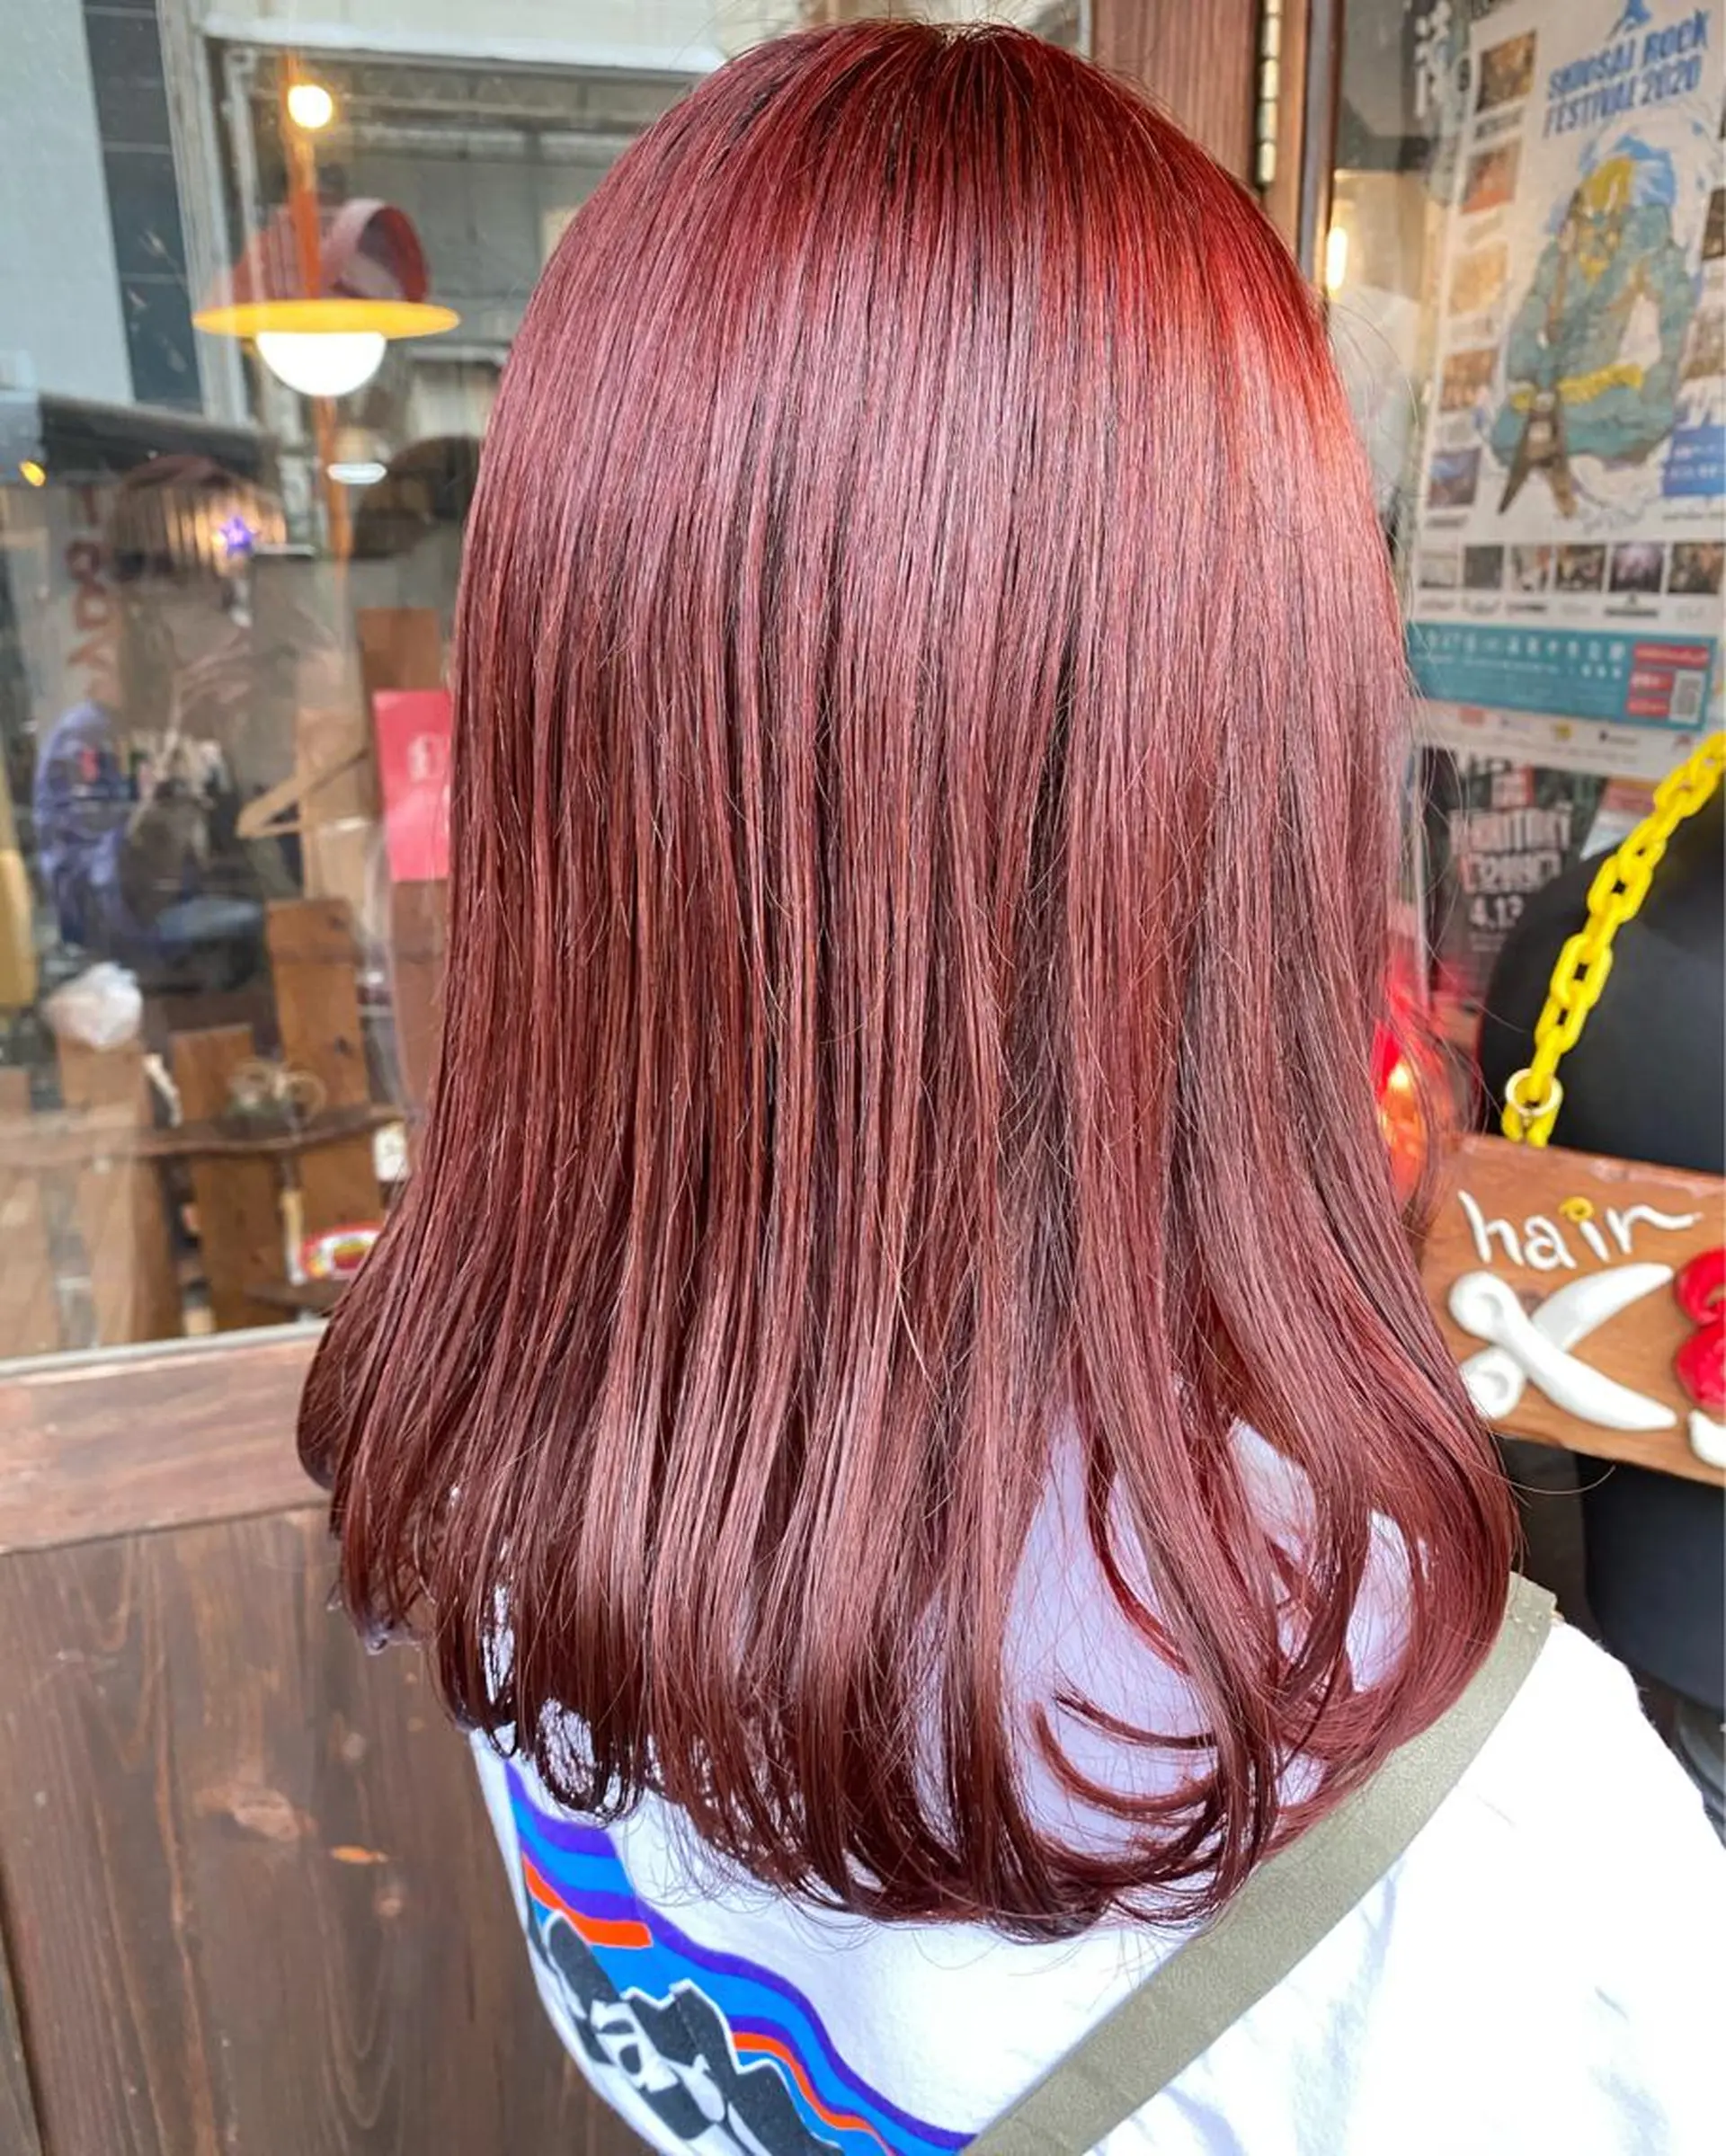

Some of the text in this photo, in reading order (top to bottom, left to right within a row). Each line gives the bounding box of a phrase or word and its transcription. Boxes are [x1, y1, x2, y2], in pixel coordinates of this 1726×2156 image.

[1643, 8, 1710, 66] ROCK
[1542, 75, 1639, 140] FESTIVAL
[1641, 55, 1702, 105] 2020
[1457, 1189, 1702, 1270] hair
